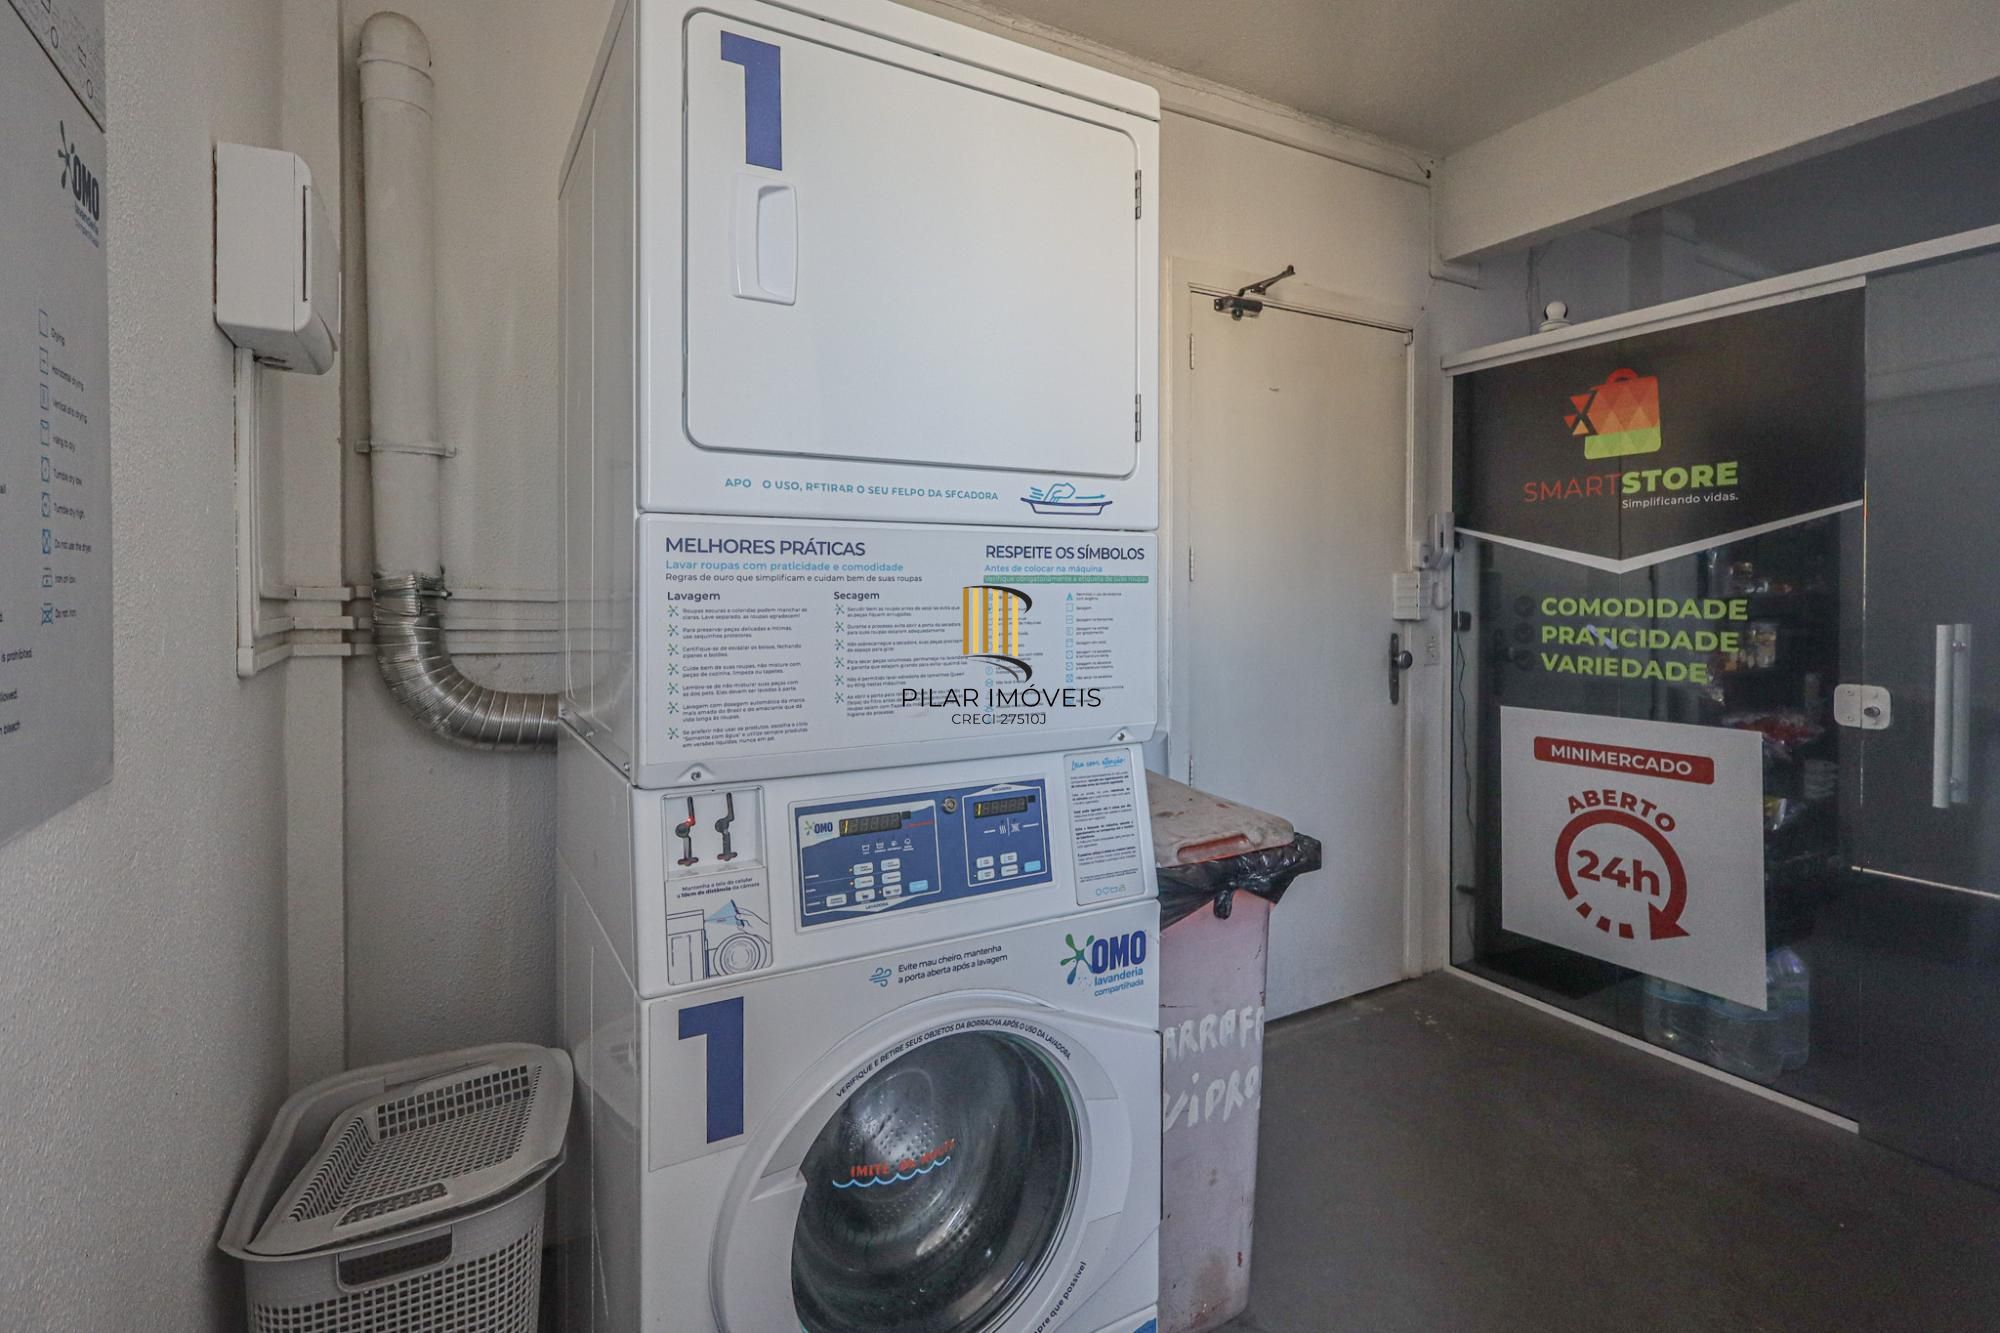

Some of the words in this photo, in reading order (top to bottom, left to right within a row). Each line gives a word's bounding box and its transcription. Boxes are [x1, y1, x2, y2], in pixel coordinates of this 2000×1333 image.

[721, 30, 782, 170] 1
[74, 154, 100, 221] OMO
[774, 480, 802, 491] USO,
[857, 485, 865, 494] O
[868, 485, 889, 495] SEU
[892, 486, 925, 497] FELPO
[928, 488, 942, 498] DA
[1622, 494, 1700, 509] Simplificando
[1704, 492, 1739, 503] vidas.
[666, 538, 775, 555] MELHORES
[780, 538, 866, 556] PRÁTICAS
[986, 545, 1052, 559] RESPEITE
[1056, 547, 1074, 559] OS
[1077, 544, 1144, 560] SÍMBOLOS
[666, 560, 698, 570] Lavar
[700, 562, 740, 571] roupas
[743, 562, 767, 570] com
[770, 562, 830, 572] praticidade
[842, 562, 904, 572] comodidade
[984, 564, 1009, 572] Antes
[1024, 565, 1054, 573] colocar
[1068, 565, 1102, 574] máquina
[666, 573, 697, 582] Regras
[736, 575, 754, 583] que
[755, 574, 805, 583] simplificam
[667, 592, 720, 602] Lavagem
[833, 592, 880, 601] Secagem
[1541, 596, 1748, 621] COMODIDADE
[1541, 624, 1740, 652] PRATICIDADE
[1541, 652, 1708, 684] VARIEDADE
[1550, 744, 1692, 776] MINIMERCADO
[1566, 789, 1676, 833] ABERTO
[814, 822, 833, 834] OMO
[1576, 850, 1660, 897] 24h
[898, 964, 918, 972] Evite
[919, 960, 937, 968] mau
[938, 954, 963, 964] cheiro,
[964, 945, 1002, 959] mantenha
[1092, 930, 1146, 974] OMO
[905, 972, 925, 984] porta
[927, 966, 951, 978] aberta
[952, 962, 970, 972] após
[977, 954, 1008, 966] lavagem
[1094, 967, 1144, 986] lavanderia
[1094, 978, 1144, 996] compartilhada
[836, 1064, 873, 1097] VERIFIQUE
[874, 1059, 879, 1067] E
[880, 1044, 904, 1063] RETIRE
[905, 1035, 924, 1049] SEUS
[924, 1024, 954, 1040] OBJETOS
[955, 1022, 965, 1030] DA
[966, 1019, 1001, 1028] BORRACHA
[1002, 1019, 1018, 1028] APÓS
[1024, 1024, 1037, 1034] USO
[1037, 1028, 1046, 1038] DA
[678, 996, 744, 1144] 1
[1050, 1300, 1064, 1318] que
